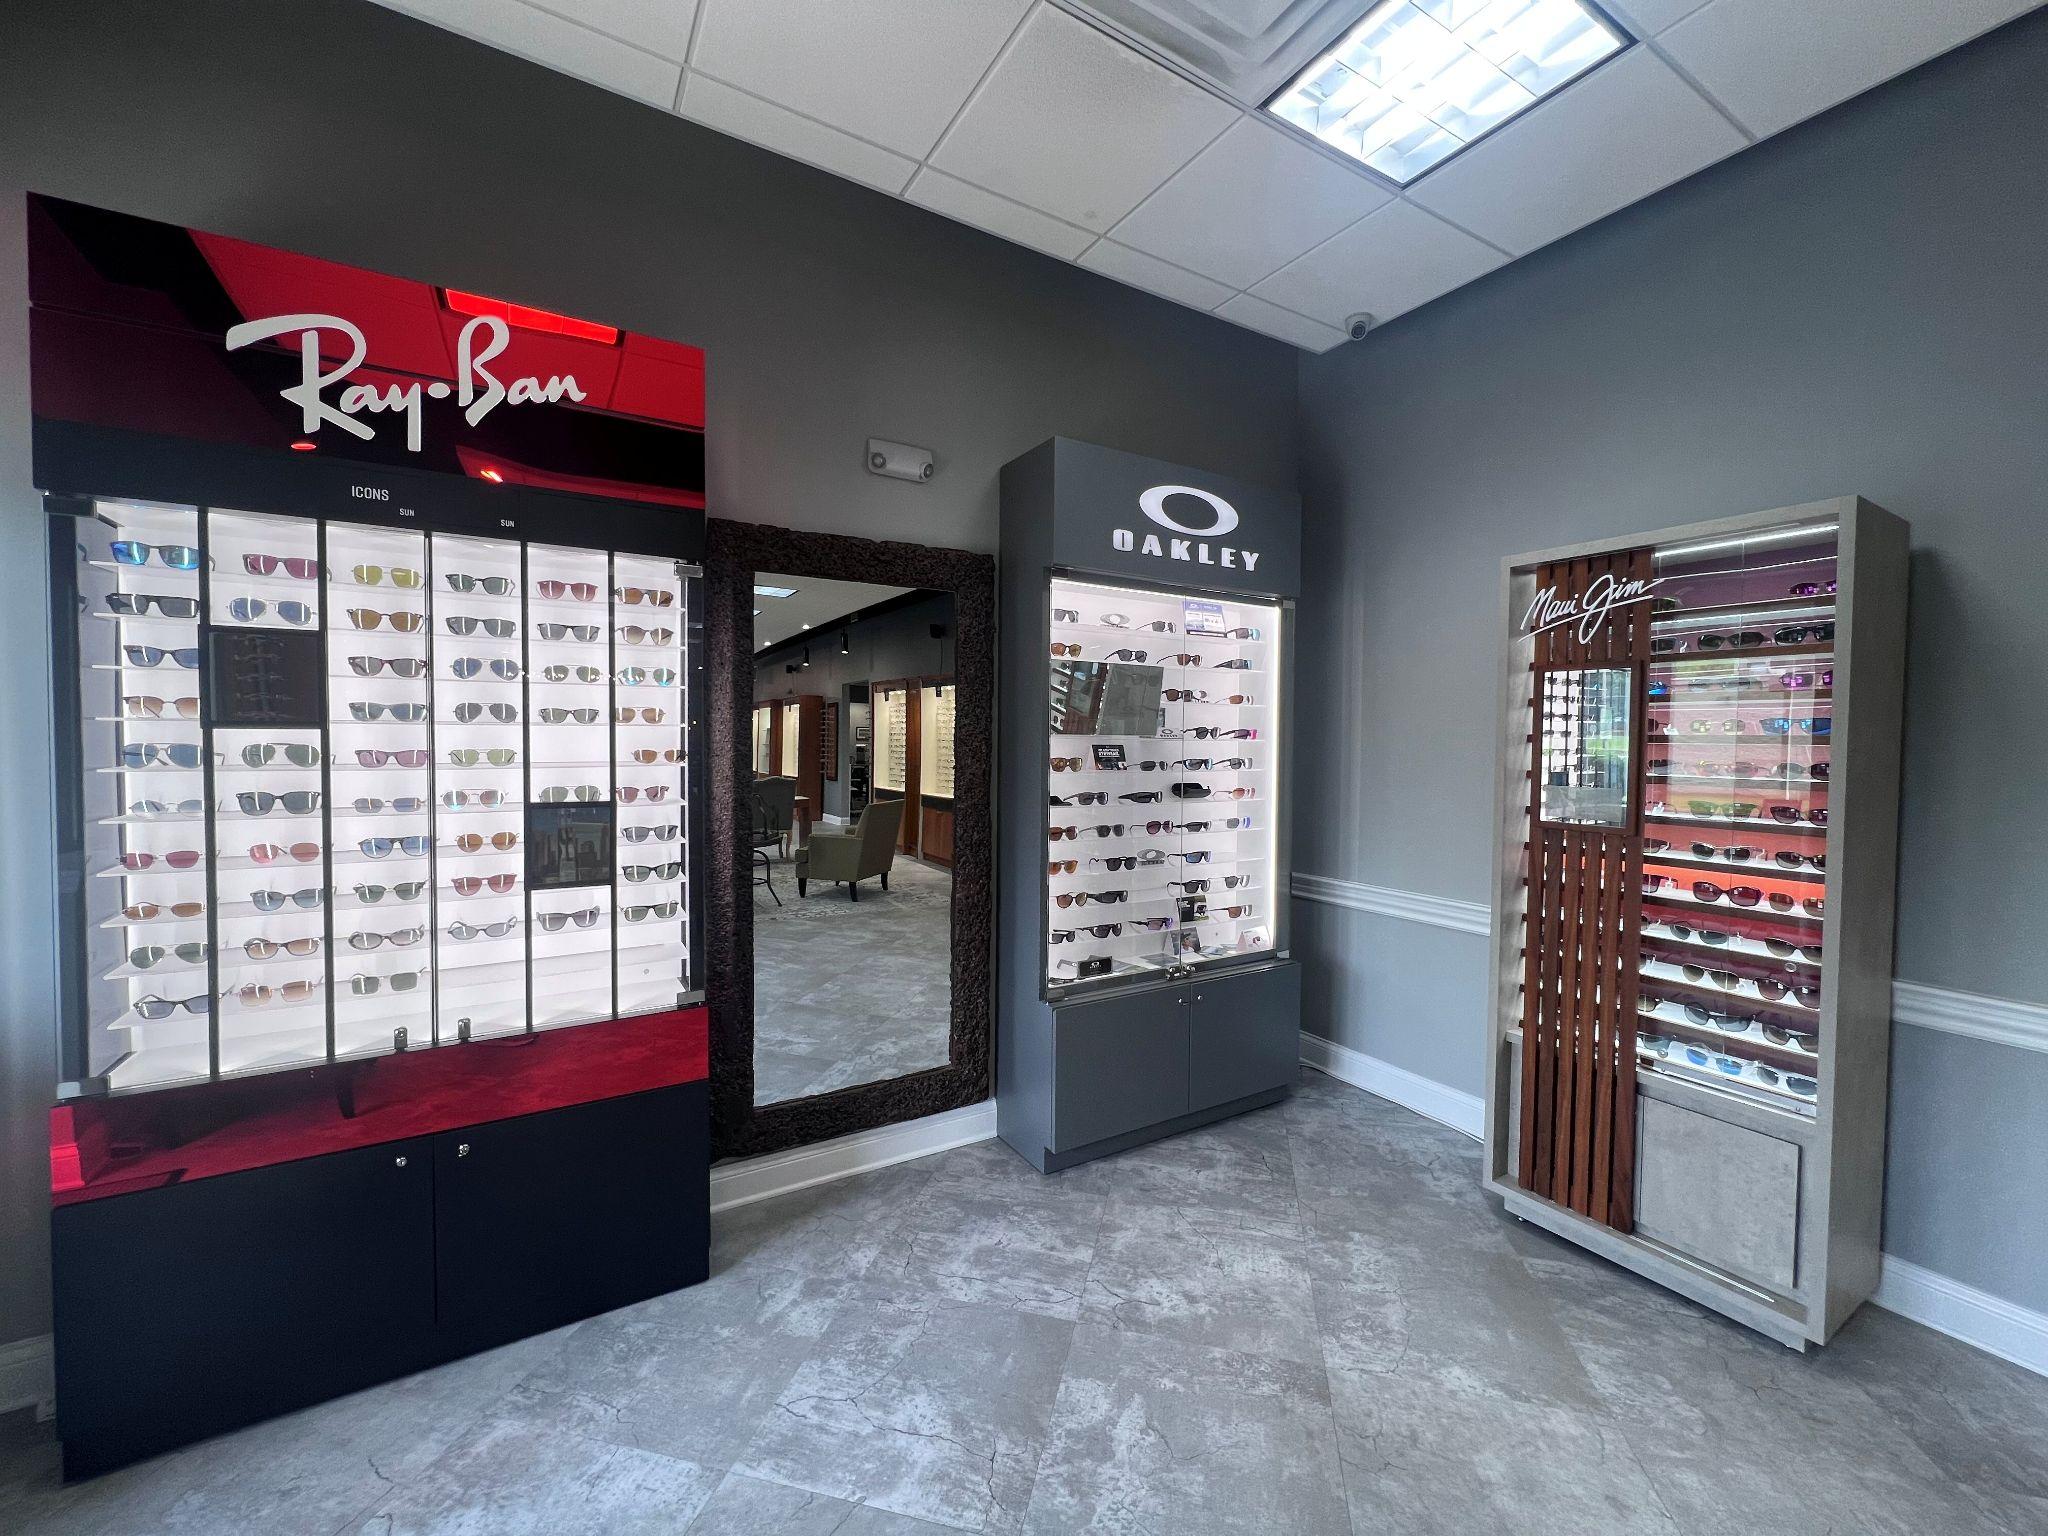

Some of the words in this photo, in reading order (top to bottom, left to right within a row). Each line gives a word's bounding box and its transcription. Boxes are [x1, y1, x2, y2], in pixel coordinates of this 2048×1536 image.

[351, 485, 390, 502] ICONS
[399, 508, 415, 517] SUN
[500, 519, 515, 528] SUN
[1112, 528, 1260, 572] OAKLEY
[1520, 585, 1578, 630] Maui
[1578, 574, 1662, 645] Jim
